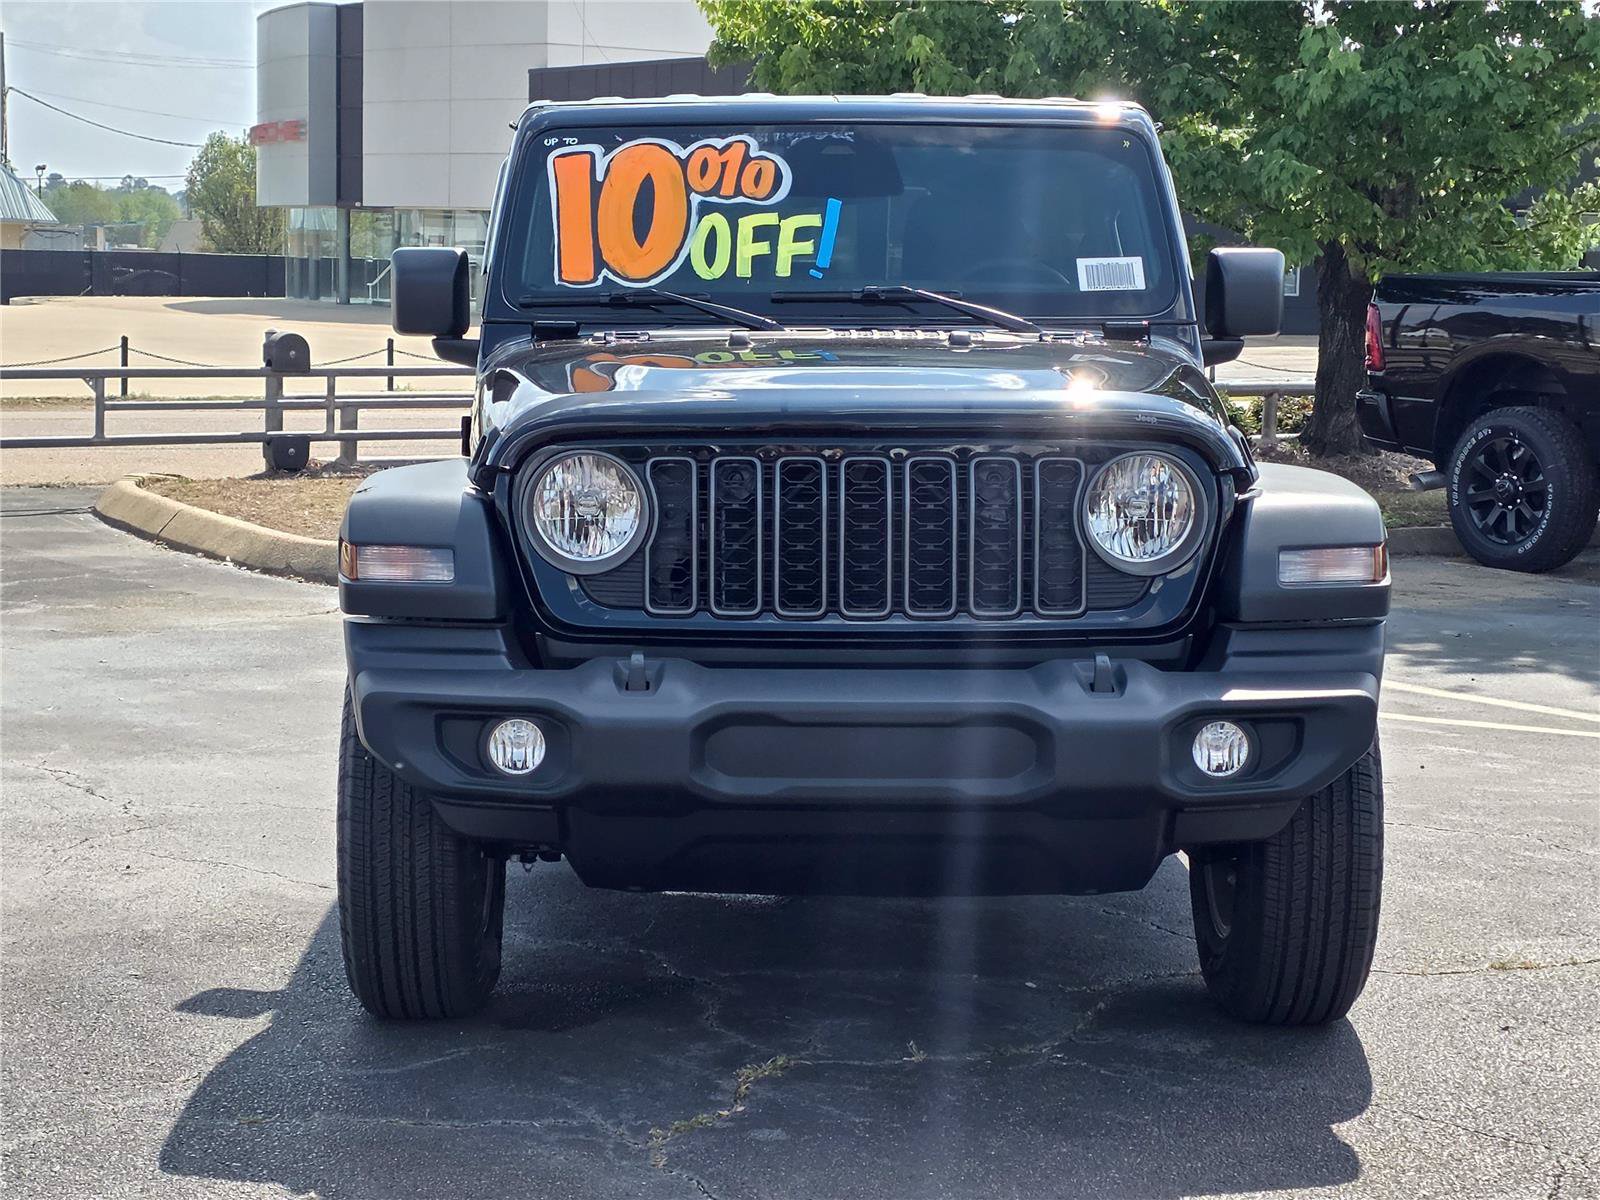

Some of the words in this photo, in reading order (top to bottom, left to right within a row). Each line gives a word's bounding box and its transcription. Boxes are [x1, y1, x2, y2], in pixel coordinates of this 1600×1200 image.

[544, 137, 559, 147] UP
[562, 137, 578, 145] TO
[549, 137, 791, 287] 10%
[690, 197, 842, 281] OFF!
[1135, 413, 1158, 425] Jeep
